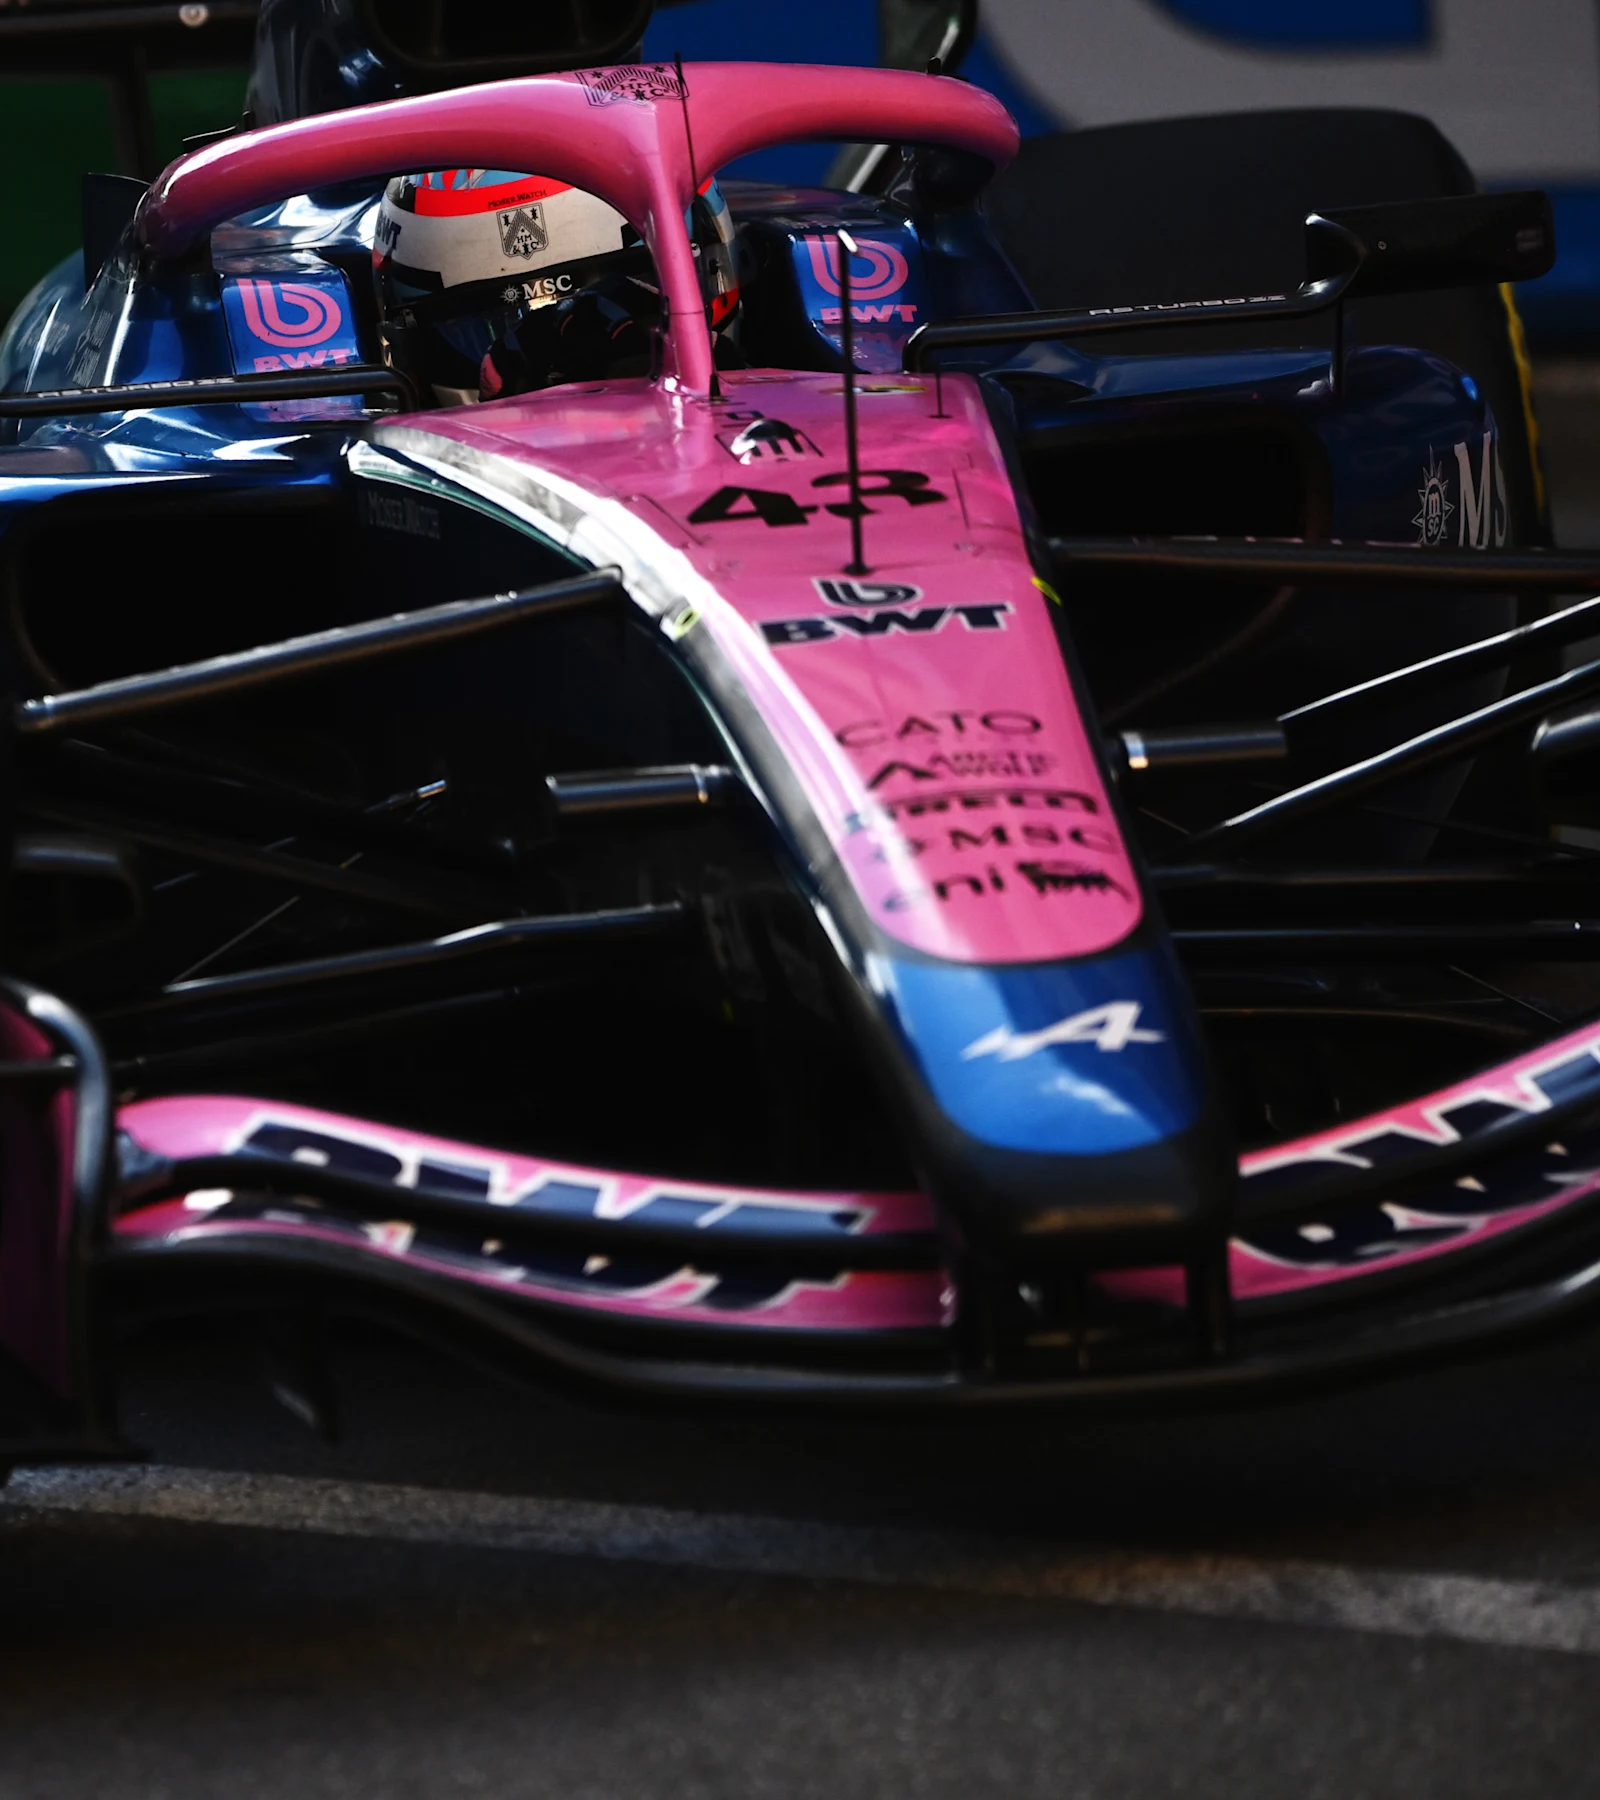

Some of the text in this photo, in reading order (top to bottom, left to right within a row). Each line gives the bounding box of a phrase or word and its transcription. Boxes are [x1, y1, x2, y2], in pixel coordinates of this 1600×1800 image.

[521, 274, 573, 301] MSC
[820, 304, 918, 325] BWT
[253, 348, 351, 373] BWT
[687, 468, 949, 528] 43
[755, 601, 1014, 645] BWT
[836, 708, 1043, 748] CATO
[949, 822, 1124, 854] MSC
[215, 1112, 878, 1312] BWT
